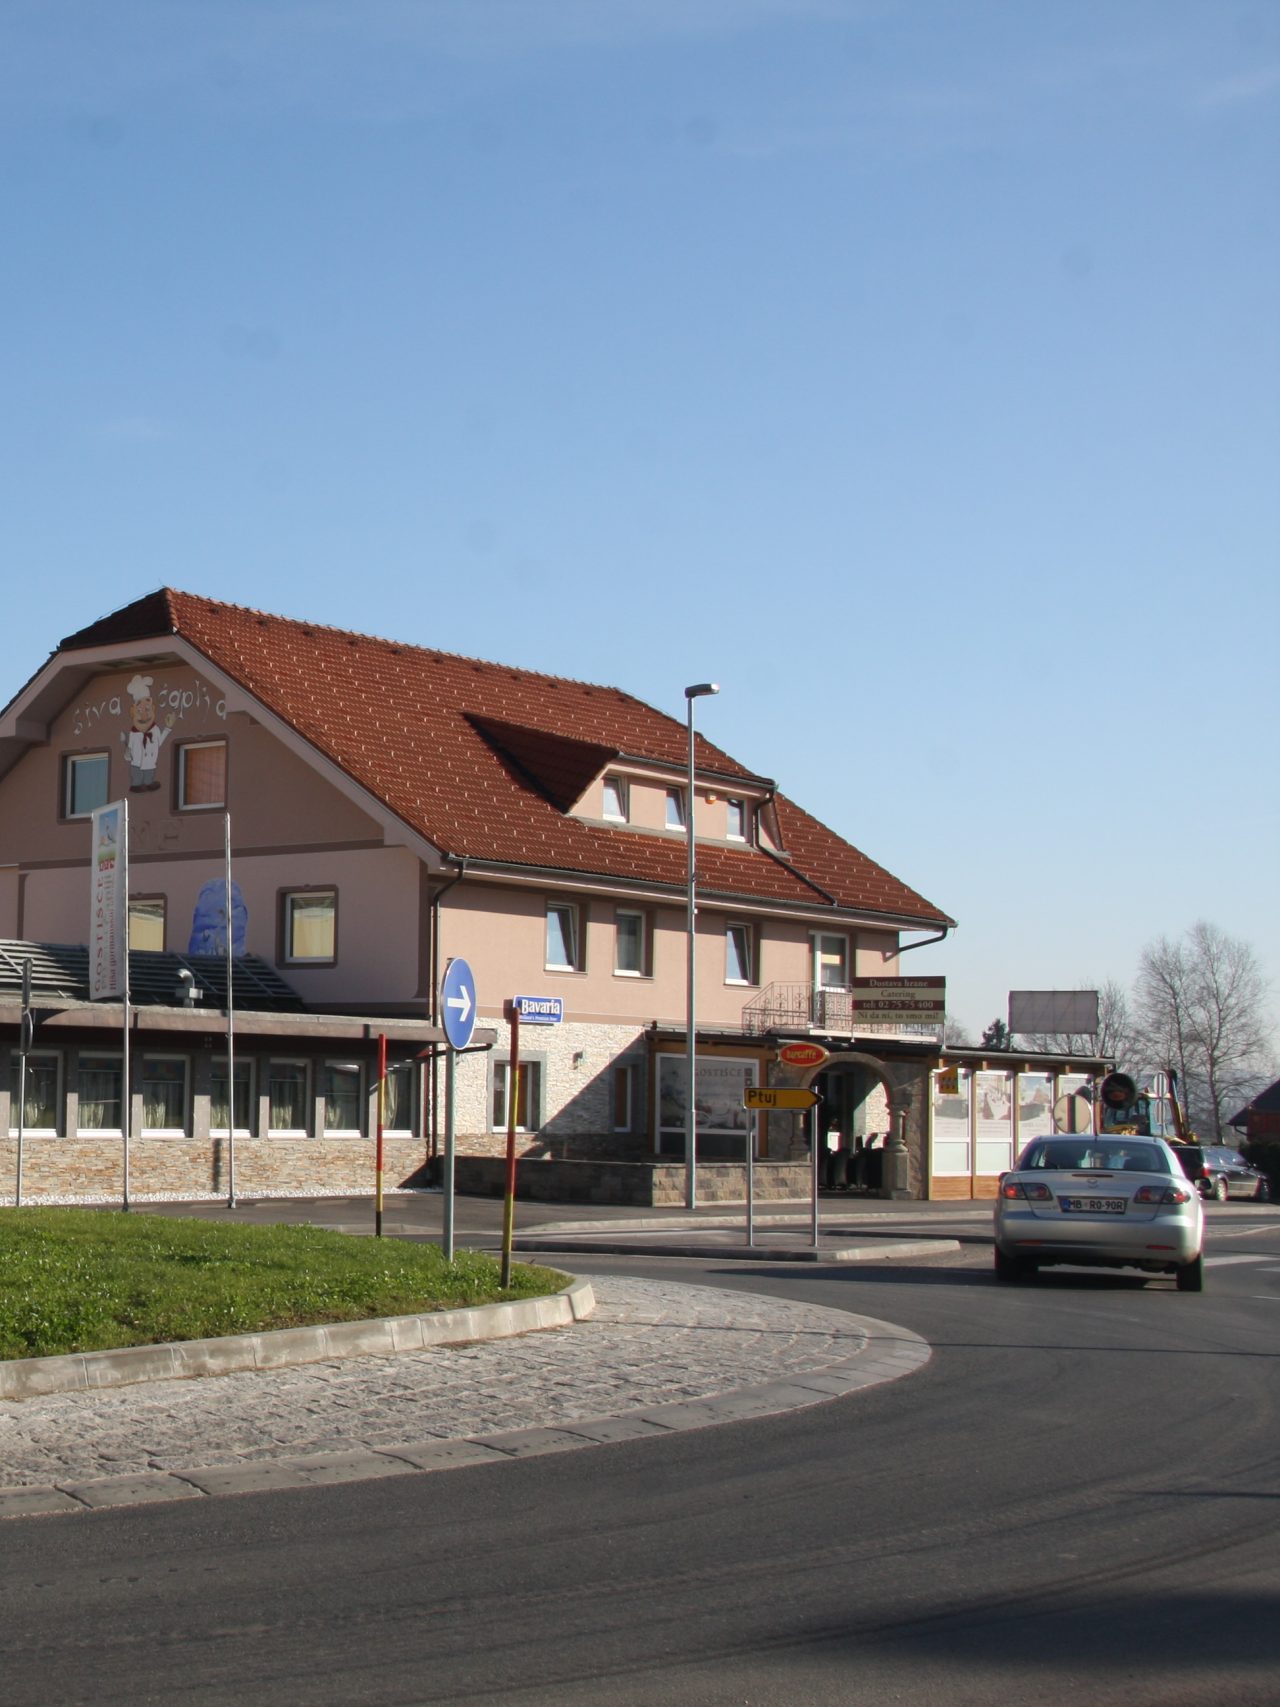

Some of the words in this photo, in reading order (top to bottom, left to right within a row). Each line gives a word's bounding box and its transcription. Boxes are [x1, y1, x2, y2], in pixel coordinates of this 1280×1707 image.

[869, 979, 902, 987] Dostava
[904, 979, 929, 987] hrane
[880, 989, 917, 999] Catering
[521, 999, 560, 1014] Bavaria
[878, 1001, 889, 1009] 02
[891, 1001, 902, 1009] 75
[904, 1001, 916, 1009] 75
[917, 1001, 934, 1009] 400
[747, 1090, 777, 1106] Ptuj
[1069, 1200, 1082, 1209] MB
